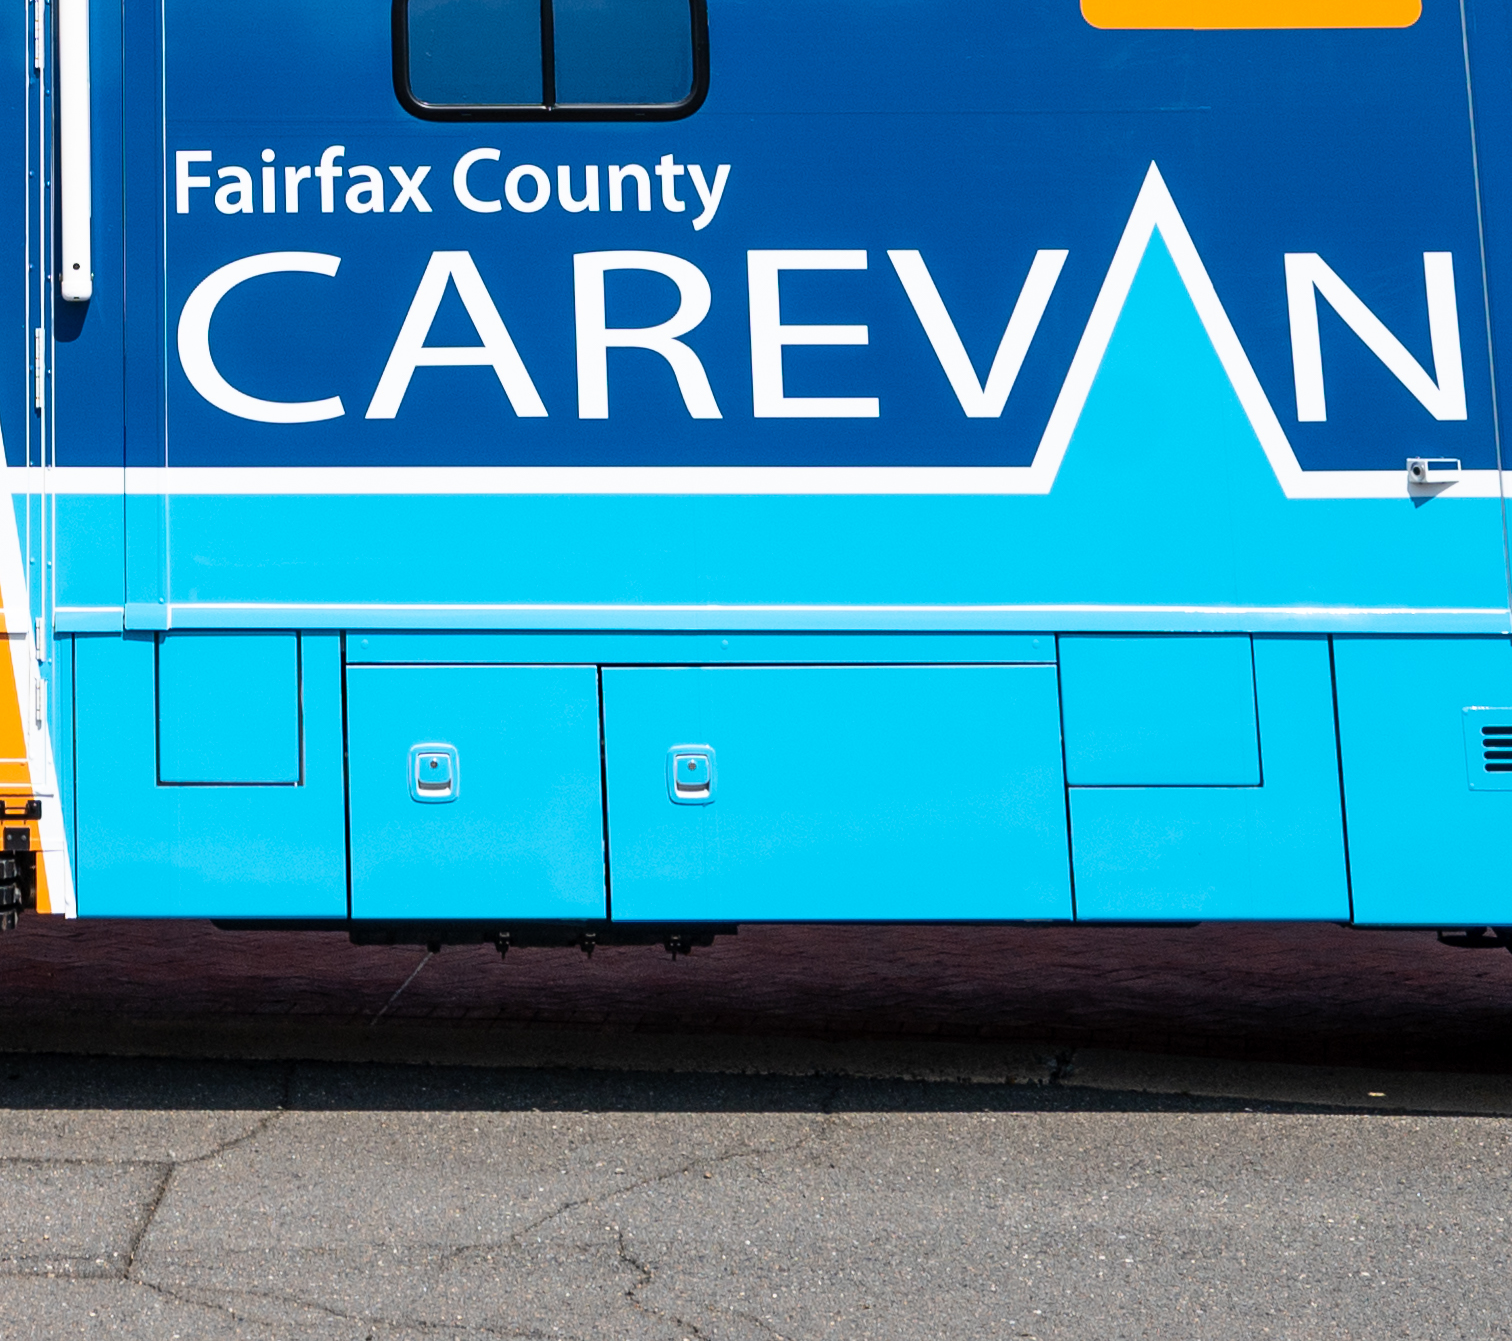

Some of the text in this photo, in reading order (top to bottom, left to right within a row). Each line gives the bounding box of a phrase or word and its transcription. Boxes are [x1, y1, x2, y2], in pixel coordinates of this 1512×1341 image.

[175, 148, 731, 231] Fairfax County
[176, 159, 1467, 429] CAREVAN
